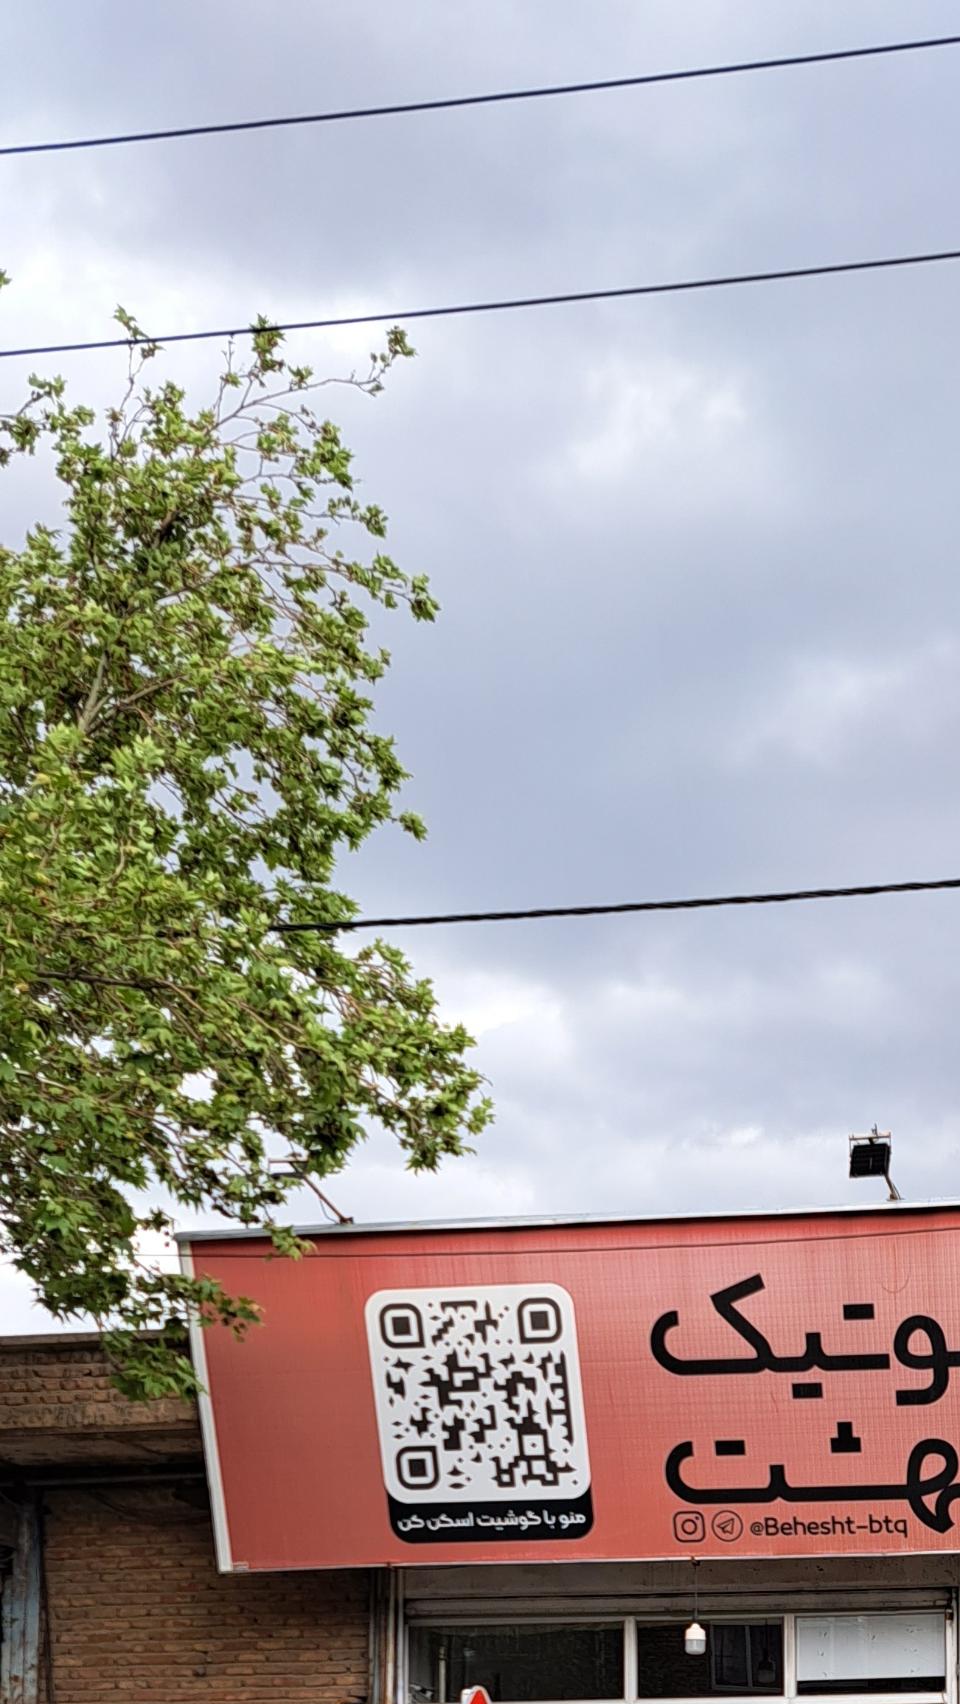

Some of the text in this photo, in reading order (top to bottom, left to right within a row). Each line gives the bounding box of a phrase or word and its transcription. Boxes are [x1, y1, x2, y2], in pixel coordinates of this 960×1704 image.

[396, 1514, 425, 1532] کن
[426, 1511, 475, 1532] اسکن
[542, 1509, 556, 1529] با
[558, 1511, 587, 1529] منو
[749, 1513, 909, 1539] @Behesht-btq
